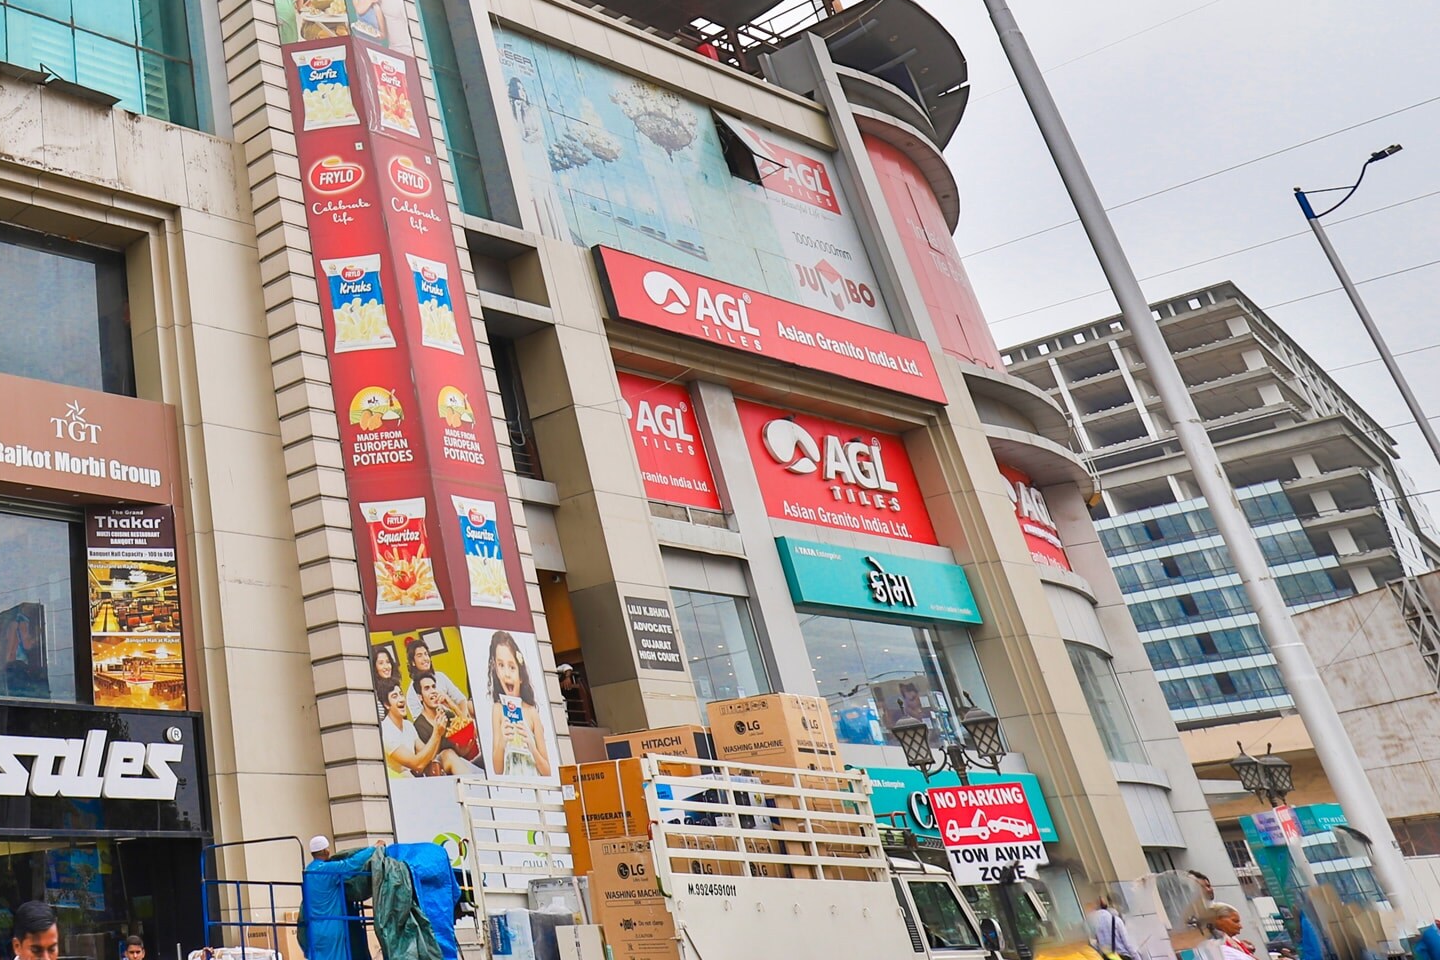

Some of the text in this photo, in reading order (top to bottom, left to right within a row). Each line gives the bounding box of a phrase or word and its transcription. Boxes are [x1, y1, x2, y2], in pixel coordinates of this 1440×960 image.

[309, 68, 338, 82] Surfiz
[381, 72, 402, 88] Surfiz
[319, 169, 355, 186] FRYLO
[397, 170, 424, 190] FRYLO
[783, 157, 830, 197] AGL
[788, 184, 833, 208] TILES
[312, 197, 372, 216] Celebrate
[391, 196, 442, 224] Celebrate
[332, 212, 354, 225] life
[409, 216, 429, 234] life
[791, 230, 853, 262] 1000x1000mm
[339, 281, 372, 295] Krinks
[421, 280, 444, 297] Krinks
[795, 258, 876, 312] JUMBO
[695, 287, 760, 337] AGL
[702, 324, 763, 352] TILES
[777, 320, 924, 378] Asian Granito India Ltd.
[50, 415, 102, 445] TGT
[636, 400, 694, 443] AGL
[356, 430, 403, 442] MADE FROM
[444, 428, 460, 438] MADE
[353, 438, 409, 453] EUROPEAN
[443, 435, 481, 453] EUROPEAN
[641, 435, 695, 456] TILES
[352, 449, 414, 467] POTATOES
[443, 446, 485, 465] POTATOES
[823, 434, 899, 493] AGL
[54, 452, 107, 479] Morbi
[109, 458, 161, 489] Group
[640, 470, 711, 493] ranito India Ltd.
[830, 485, 901, 512] TILES
[94, 516, 162, 529] Thakar
[386, 516, 405, 526] FRYLO
[783, 500, 913, 539] Asian Granito India Ltd.
[377, 528, 420, 546] Squaritoz
[466, 525, 495, 542] Squaritoz
[121, 551, 144, 559] Capacity
[799, 546, 817, 557] TATA
[627, 604, 642, 615] LILU
[633, 621, 673, 634] ADVOCATE
[641, 638, 672, 651] GUJARAT
[639, 650, 680, 663] HIGH COURT
[746, 720, 761, 731] LG
[641, 735, 682, 750] HITACHI
[723, 741, 753, 754] WASHING
[753, 739, 784, 750] MACHINE
[881, 780, 906, 789] Enterprise
[933, 786, 1023, 809] NO PARKING
[951, 844, 1042, 864] TOW AWAY
[630, 863, 645, 876] LG
[605, 889, 637, 900] WASHING
[688, 882, 737, 897] M.9924591011
